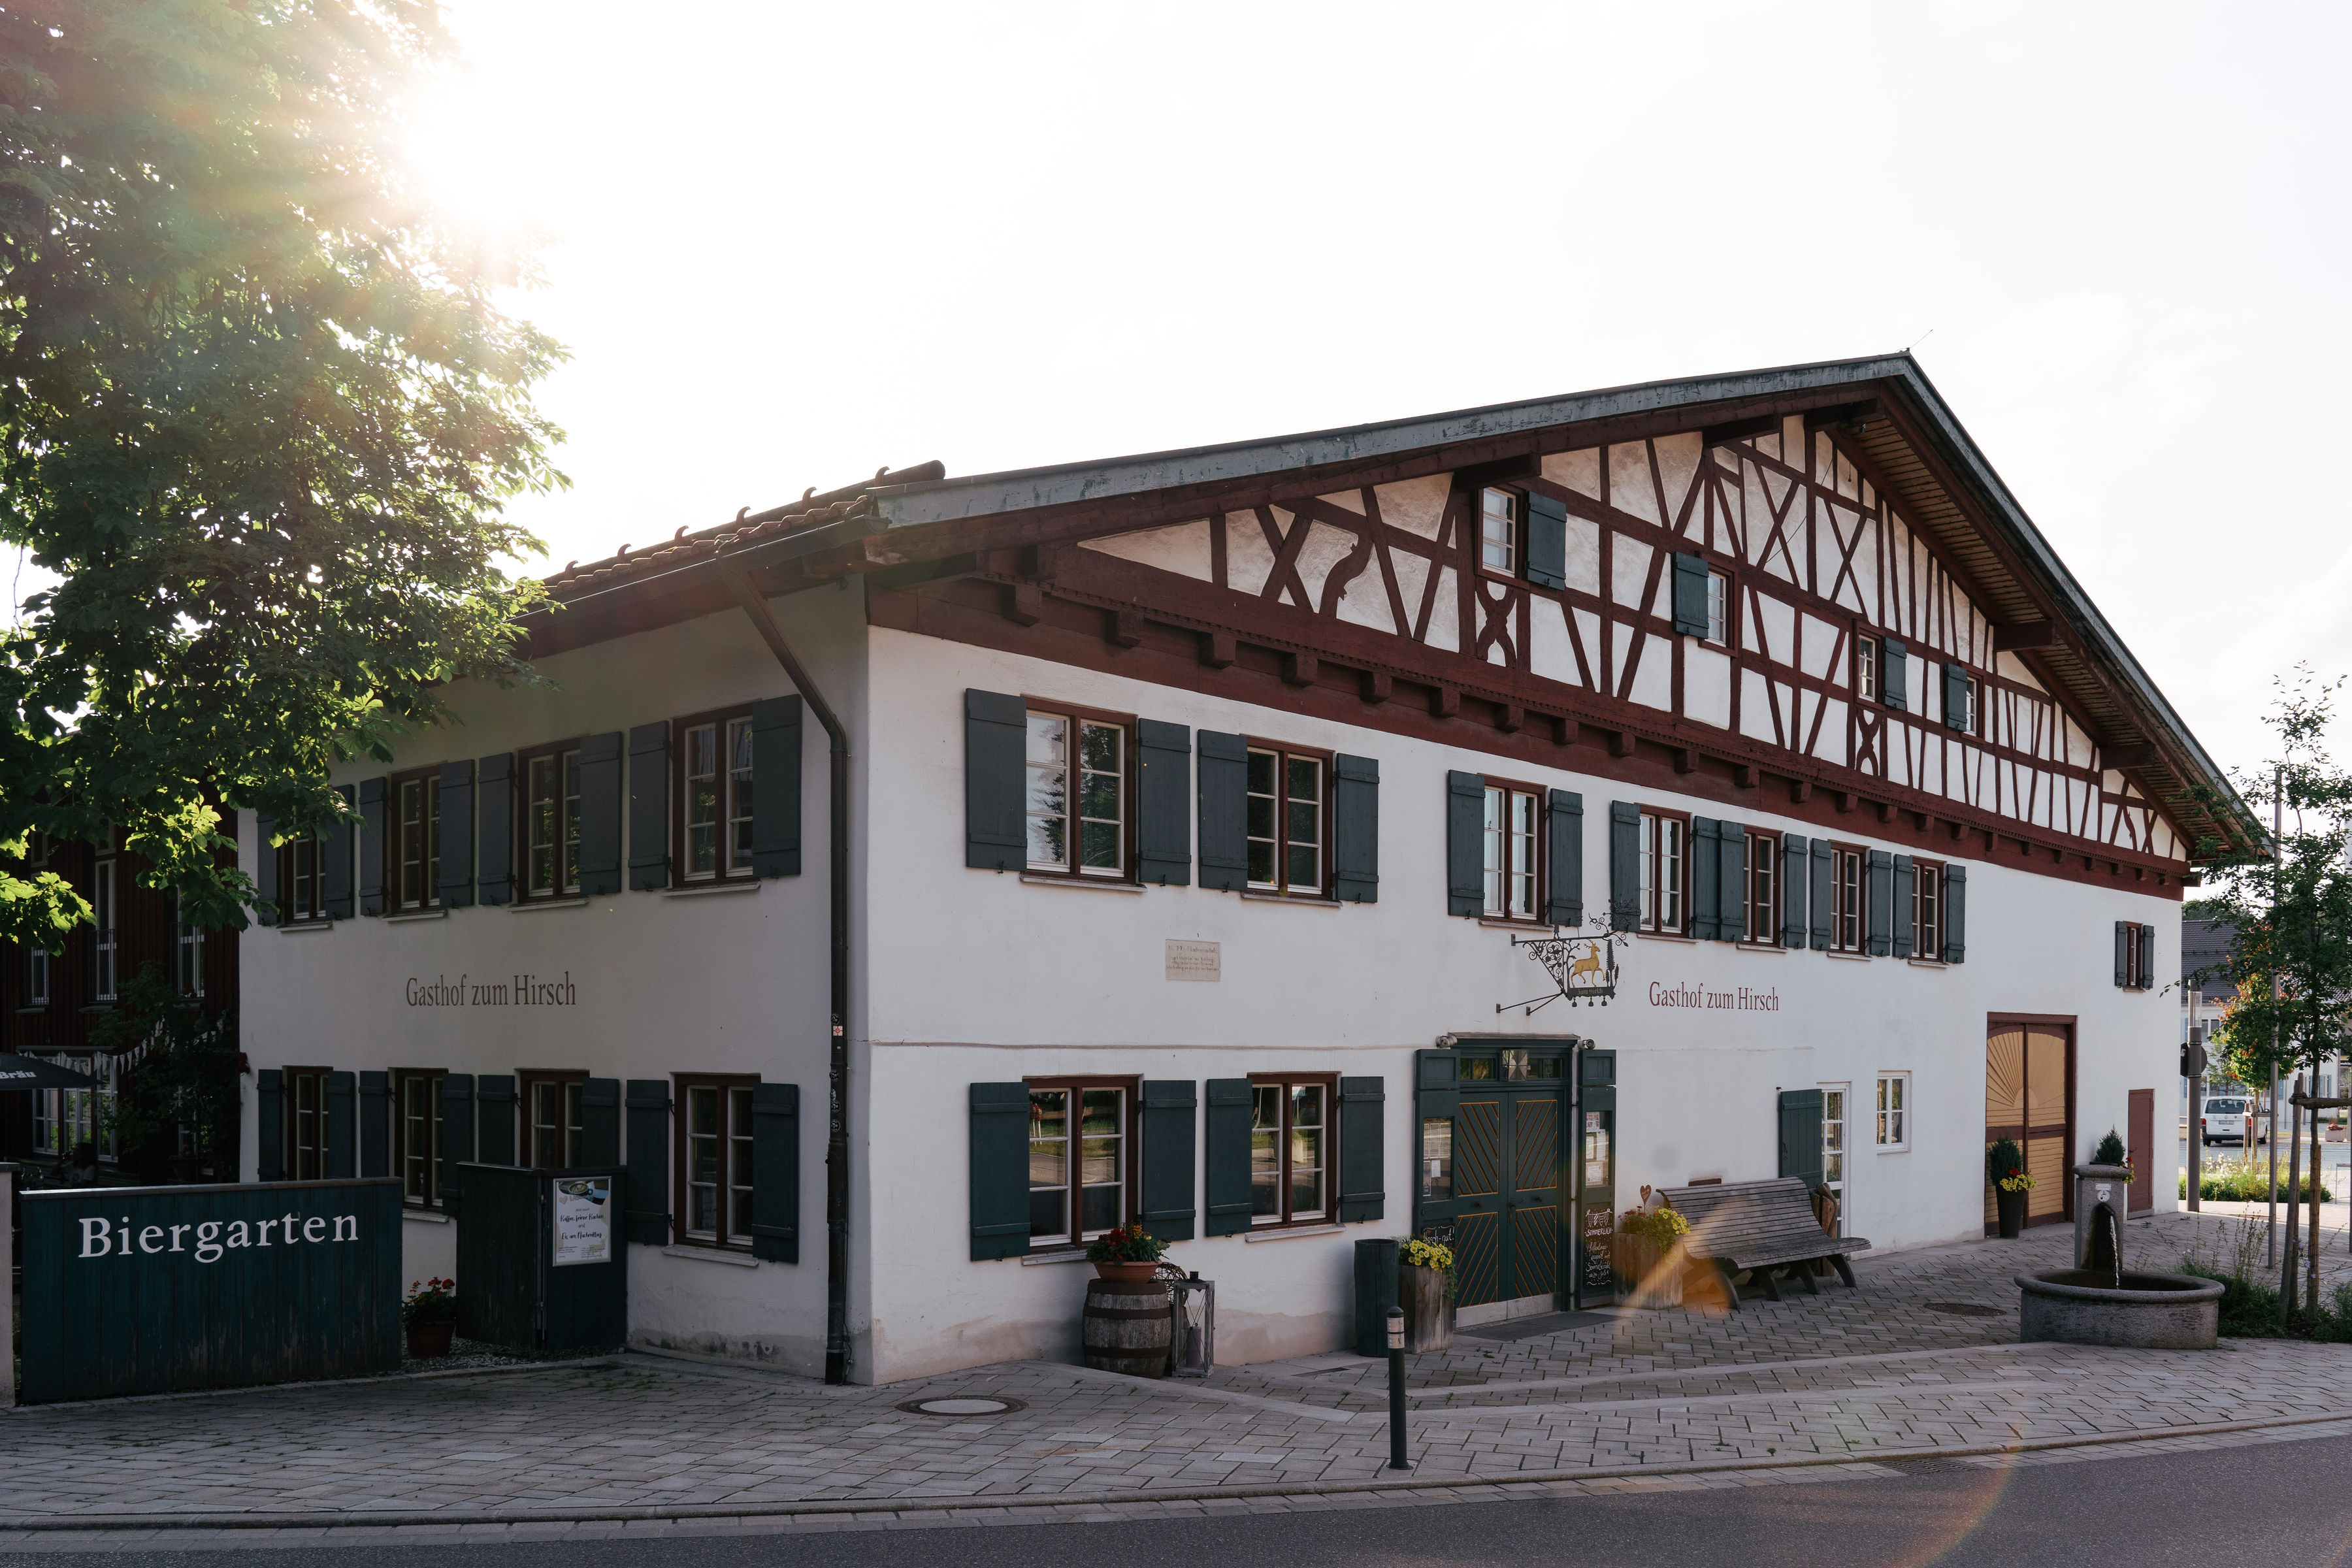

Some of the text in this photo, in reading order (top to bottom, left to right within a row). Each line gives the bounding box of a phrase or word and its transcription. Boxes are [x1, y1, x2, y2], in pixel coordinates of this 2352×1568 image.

[406, 971, 576, 1007] Gasthof zum Hirsch
[1649, 981, 1779, 1011] Gasthof zum Hirsch
[78, 1212, 359, 1264] Biergarten
